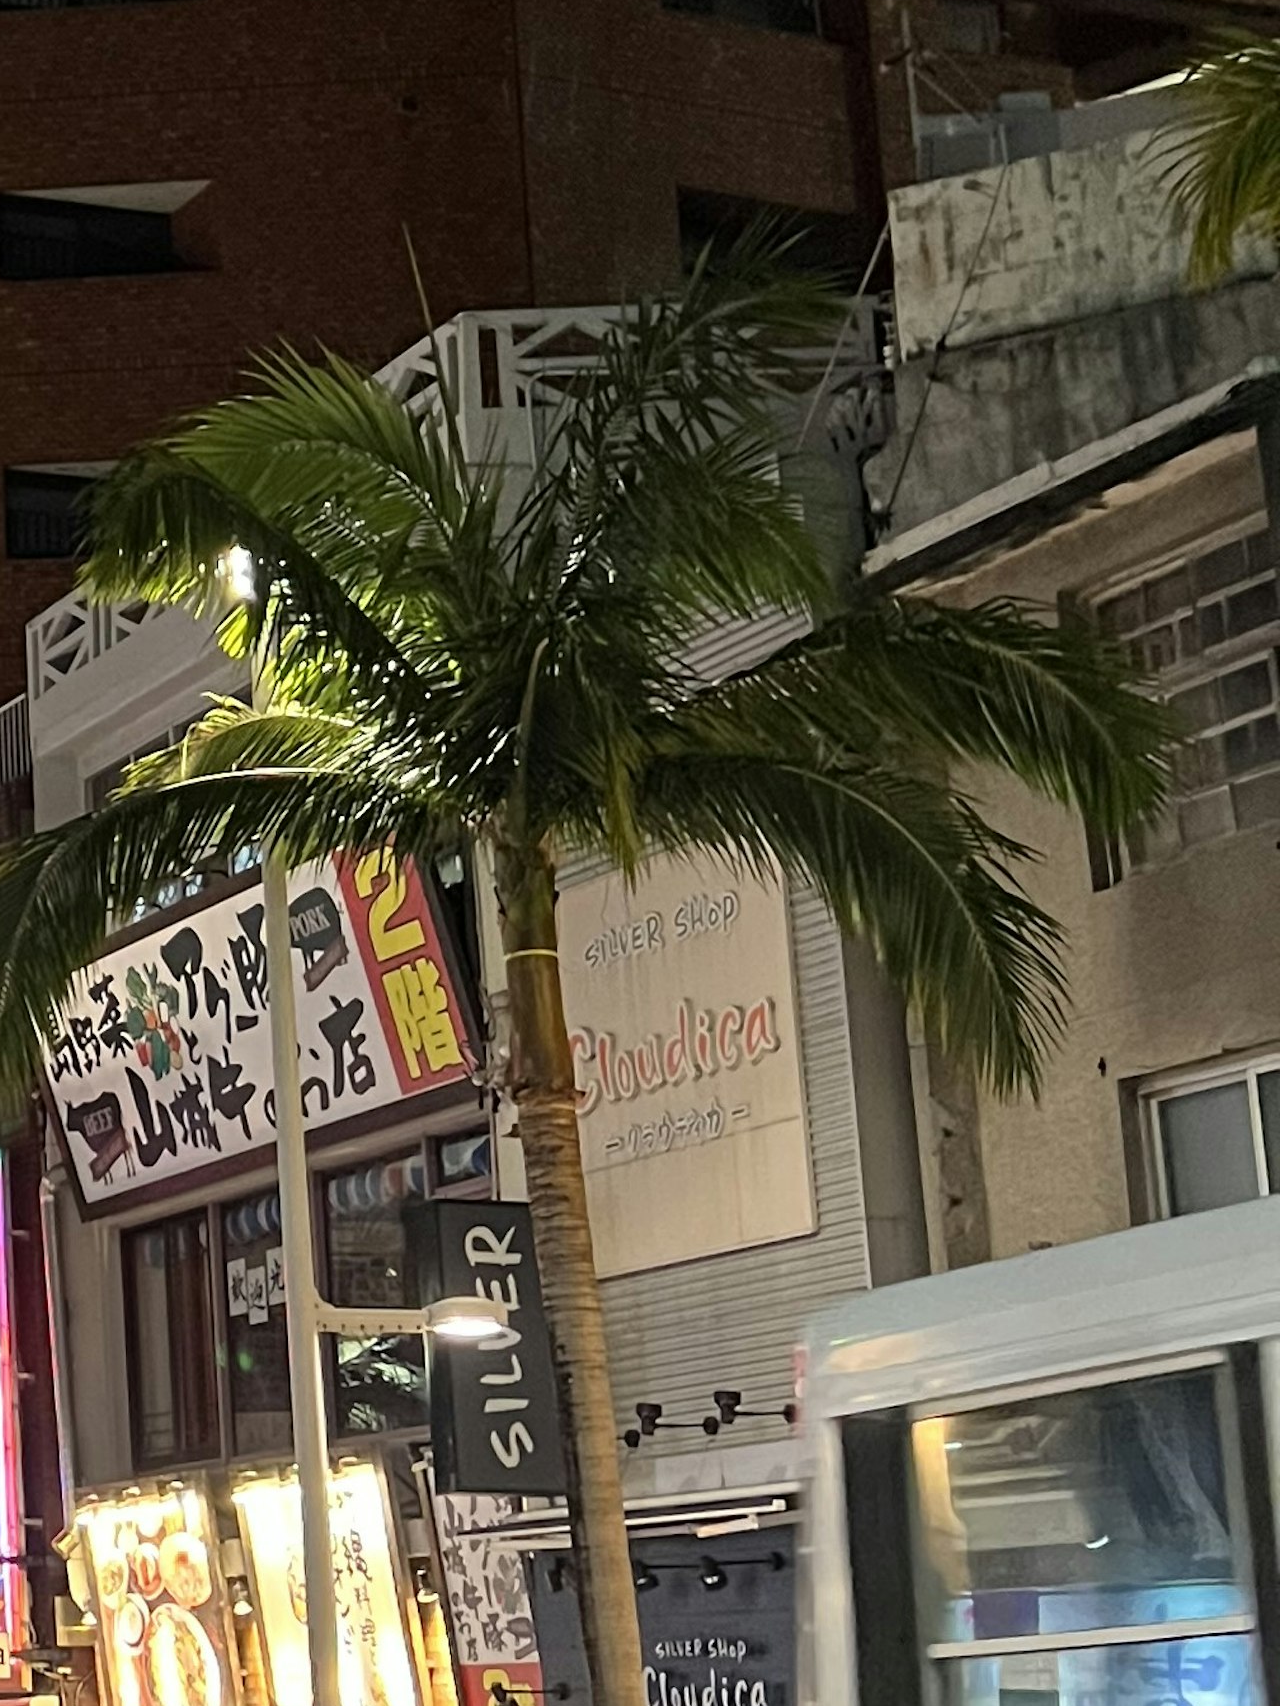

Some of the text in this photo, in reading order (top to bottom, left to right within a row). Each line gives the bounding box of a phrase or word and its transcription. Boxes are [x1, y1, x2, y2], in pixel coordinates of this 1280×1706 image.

[289, 903, 331, 943] PORK
[353, 846, 465, 1079] 2階
[584, 892, 737, 968] SILVER SHOP
[568, 997, 777, 1117] Cloudica
[464, 1225, 535, 1469] SILVER
[655, 1638, 747, 1664] SILVER SHOP
